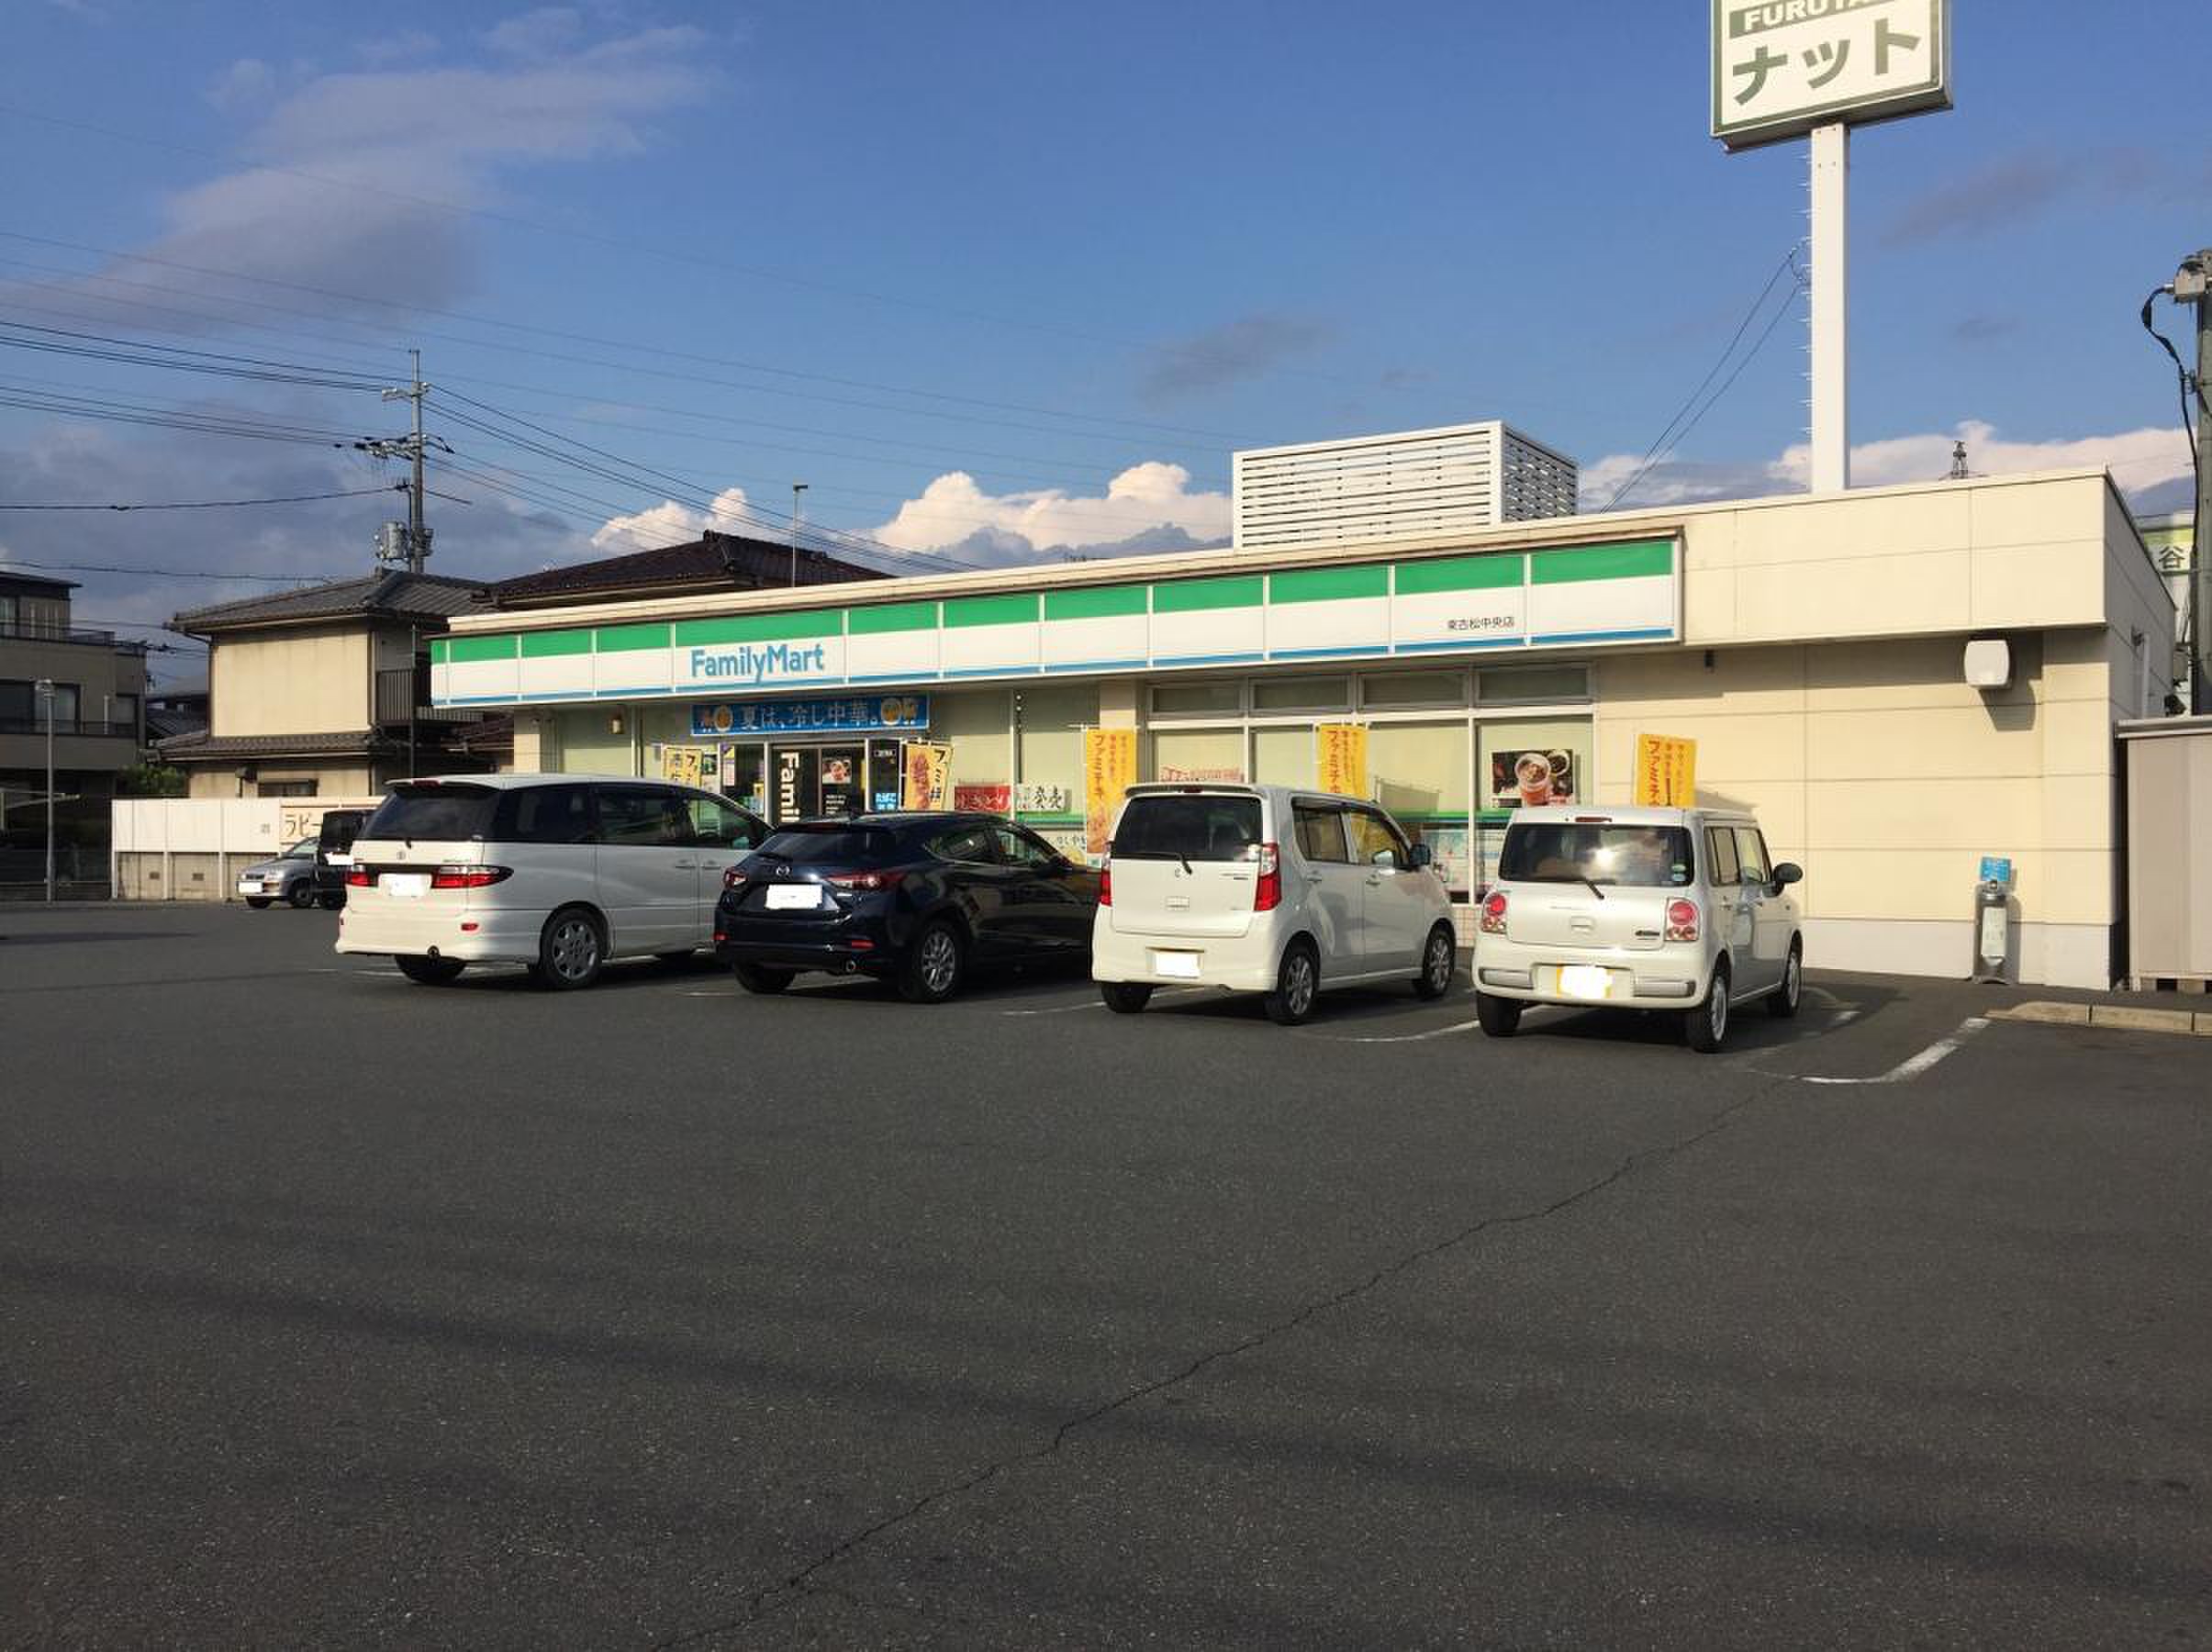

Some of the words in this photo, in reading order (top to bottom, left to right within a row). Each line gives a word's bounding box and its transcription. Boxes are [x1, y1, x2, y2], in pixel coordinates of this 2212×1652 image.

[1732, 17, 1920, 106] ナット
[2158, 545, 2185, 570] 谷
[691, 642, 824, 683] FamilyMart
